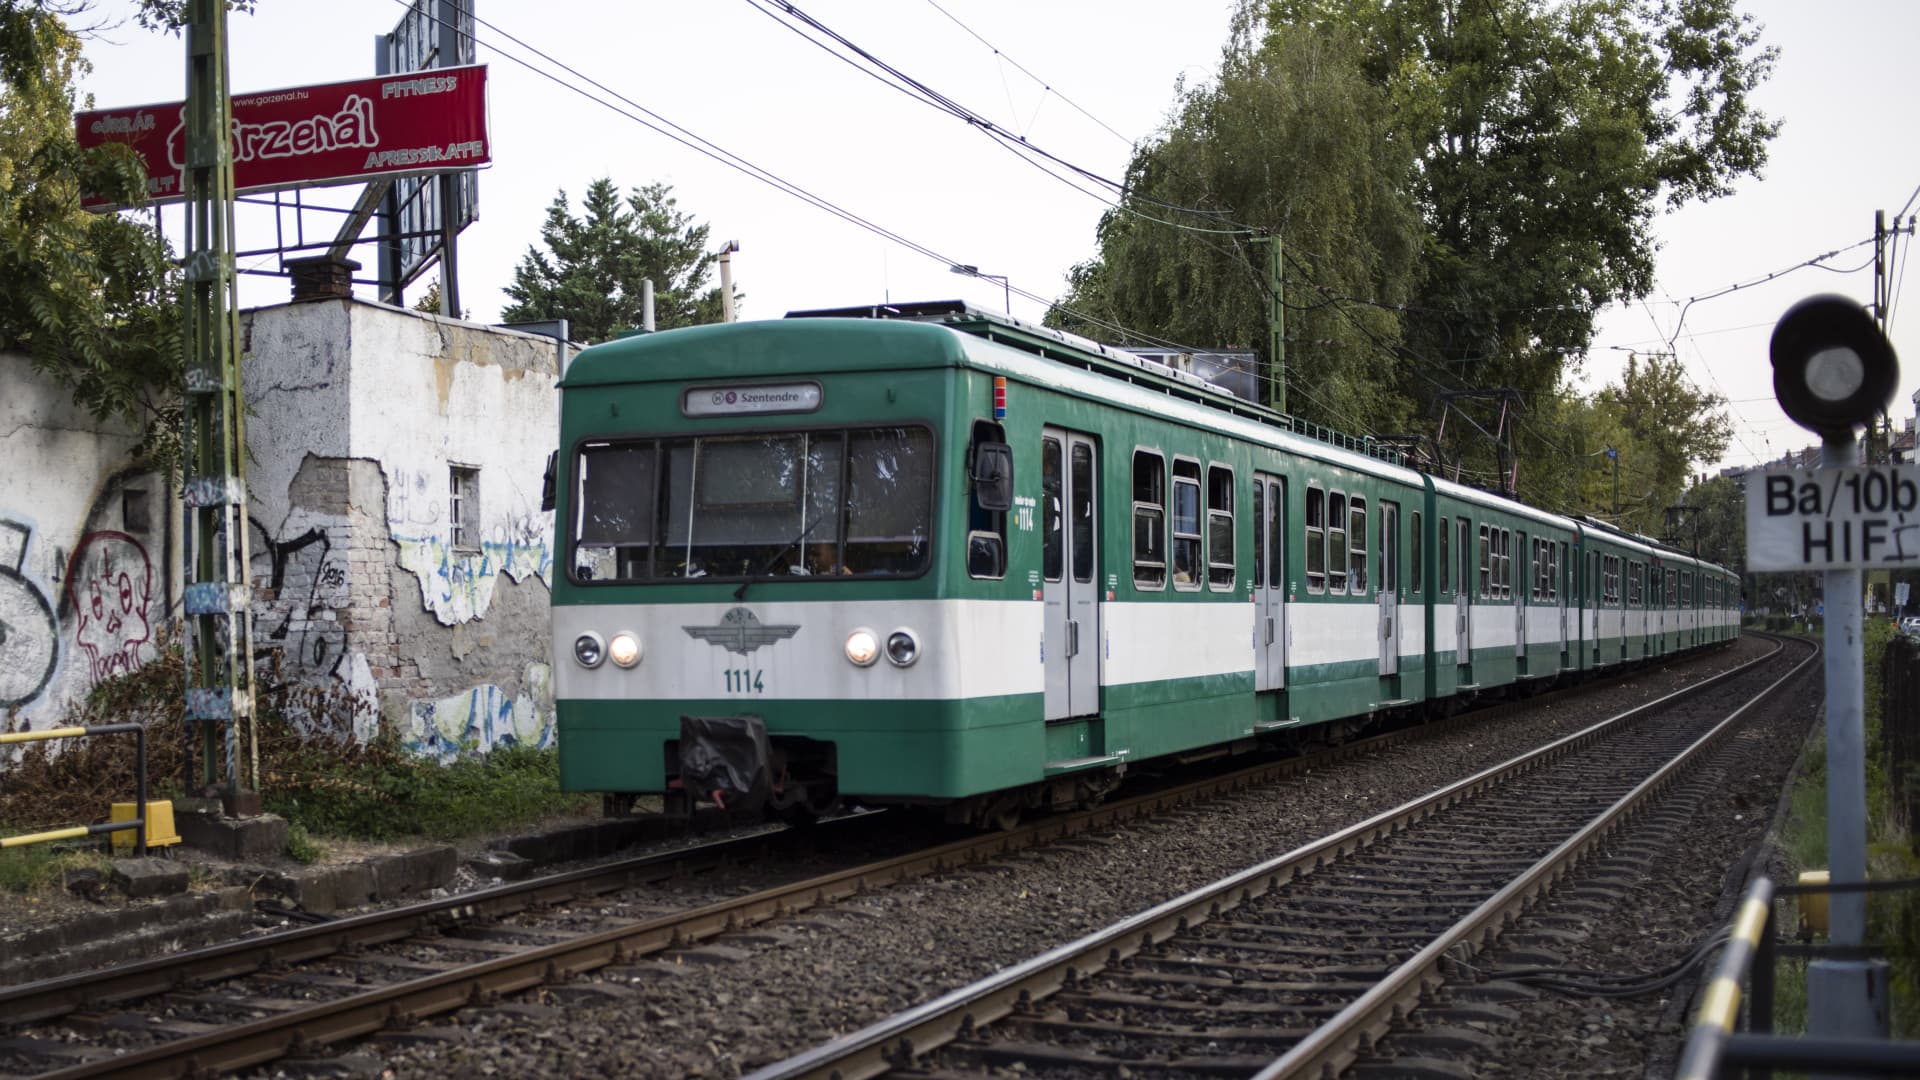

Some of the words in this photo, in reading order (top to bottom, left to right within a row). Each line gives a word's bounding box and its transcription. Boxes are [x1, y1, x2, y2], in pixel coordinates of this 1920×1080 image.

[382, 76, 457, 100] FITNESS
[741, 391, 799, 403] Szentendre
[1766, 468, 1917, 518] Ba/10b
[1019, 507, 1034, 531] 1114
[724, 669, 764, 693] 1114
